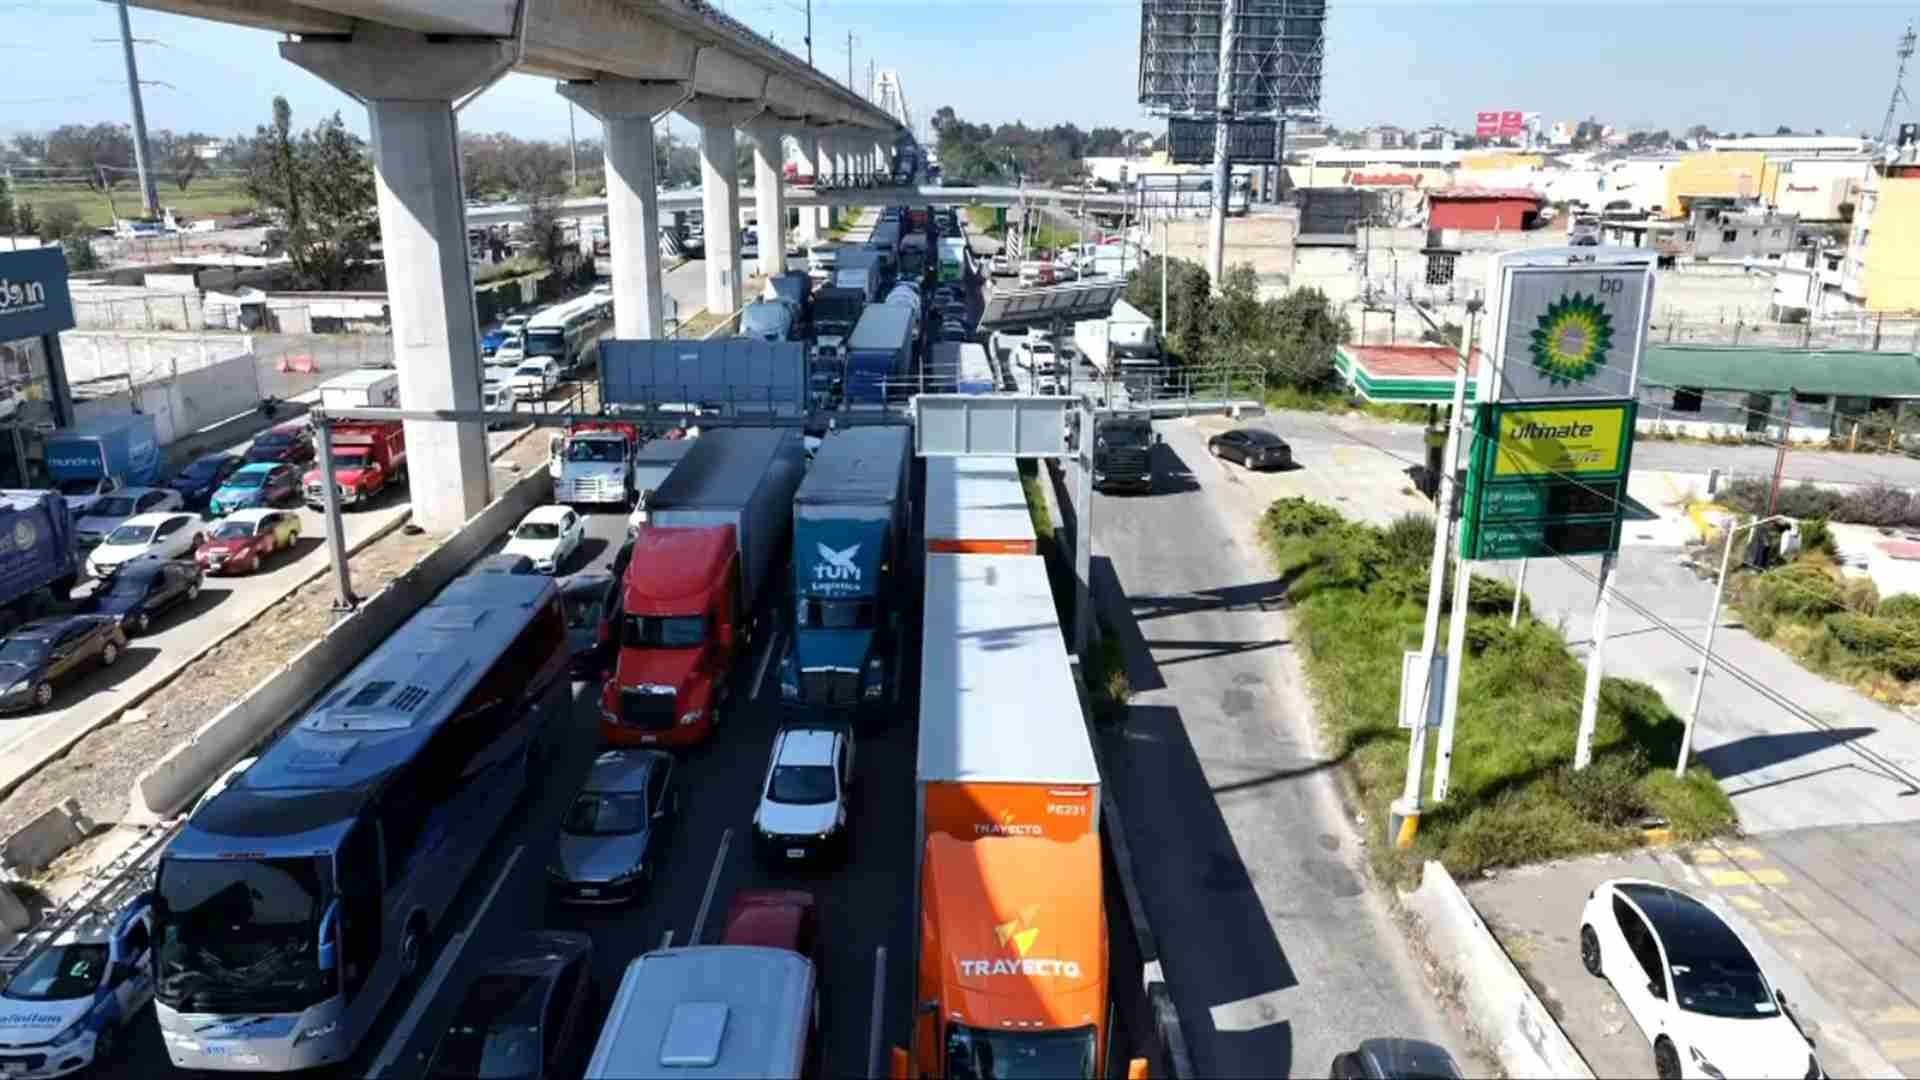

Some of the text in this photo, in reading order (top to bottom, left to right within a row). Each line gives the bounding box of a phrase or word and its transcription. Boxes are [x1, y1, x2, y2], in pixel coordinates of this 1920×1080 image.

[1600, 275, 1624, 294] bp
[1511, 421, 1594, 441] ultimate
[973, 823, 1043, 835] TRAYECTO
[960, 959, 1080, 977] TRAYECTO
